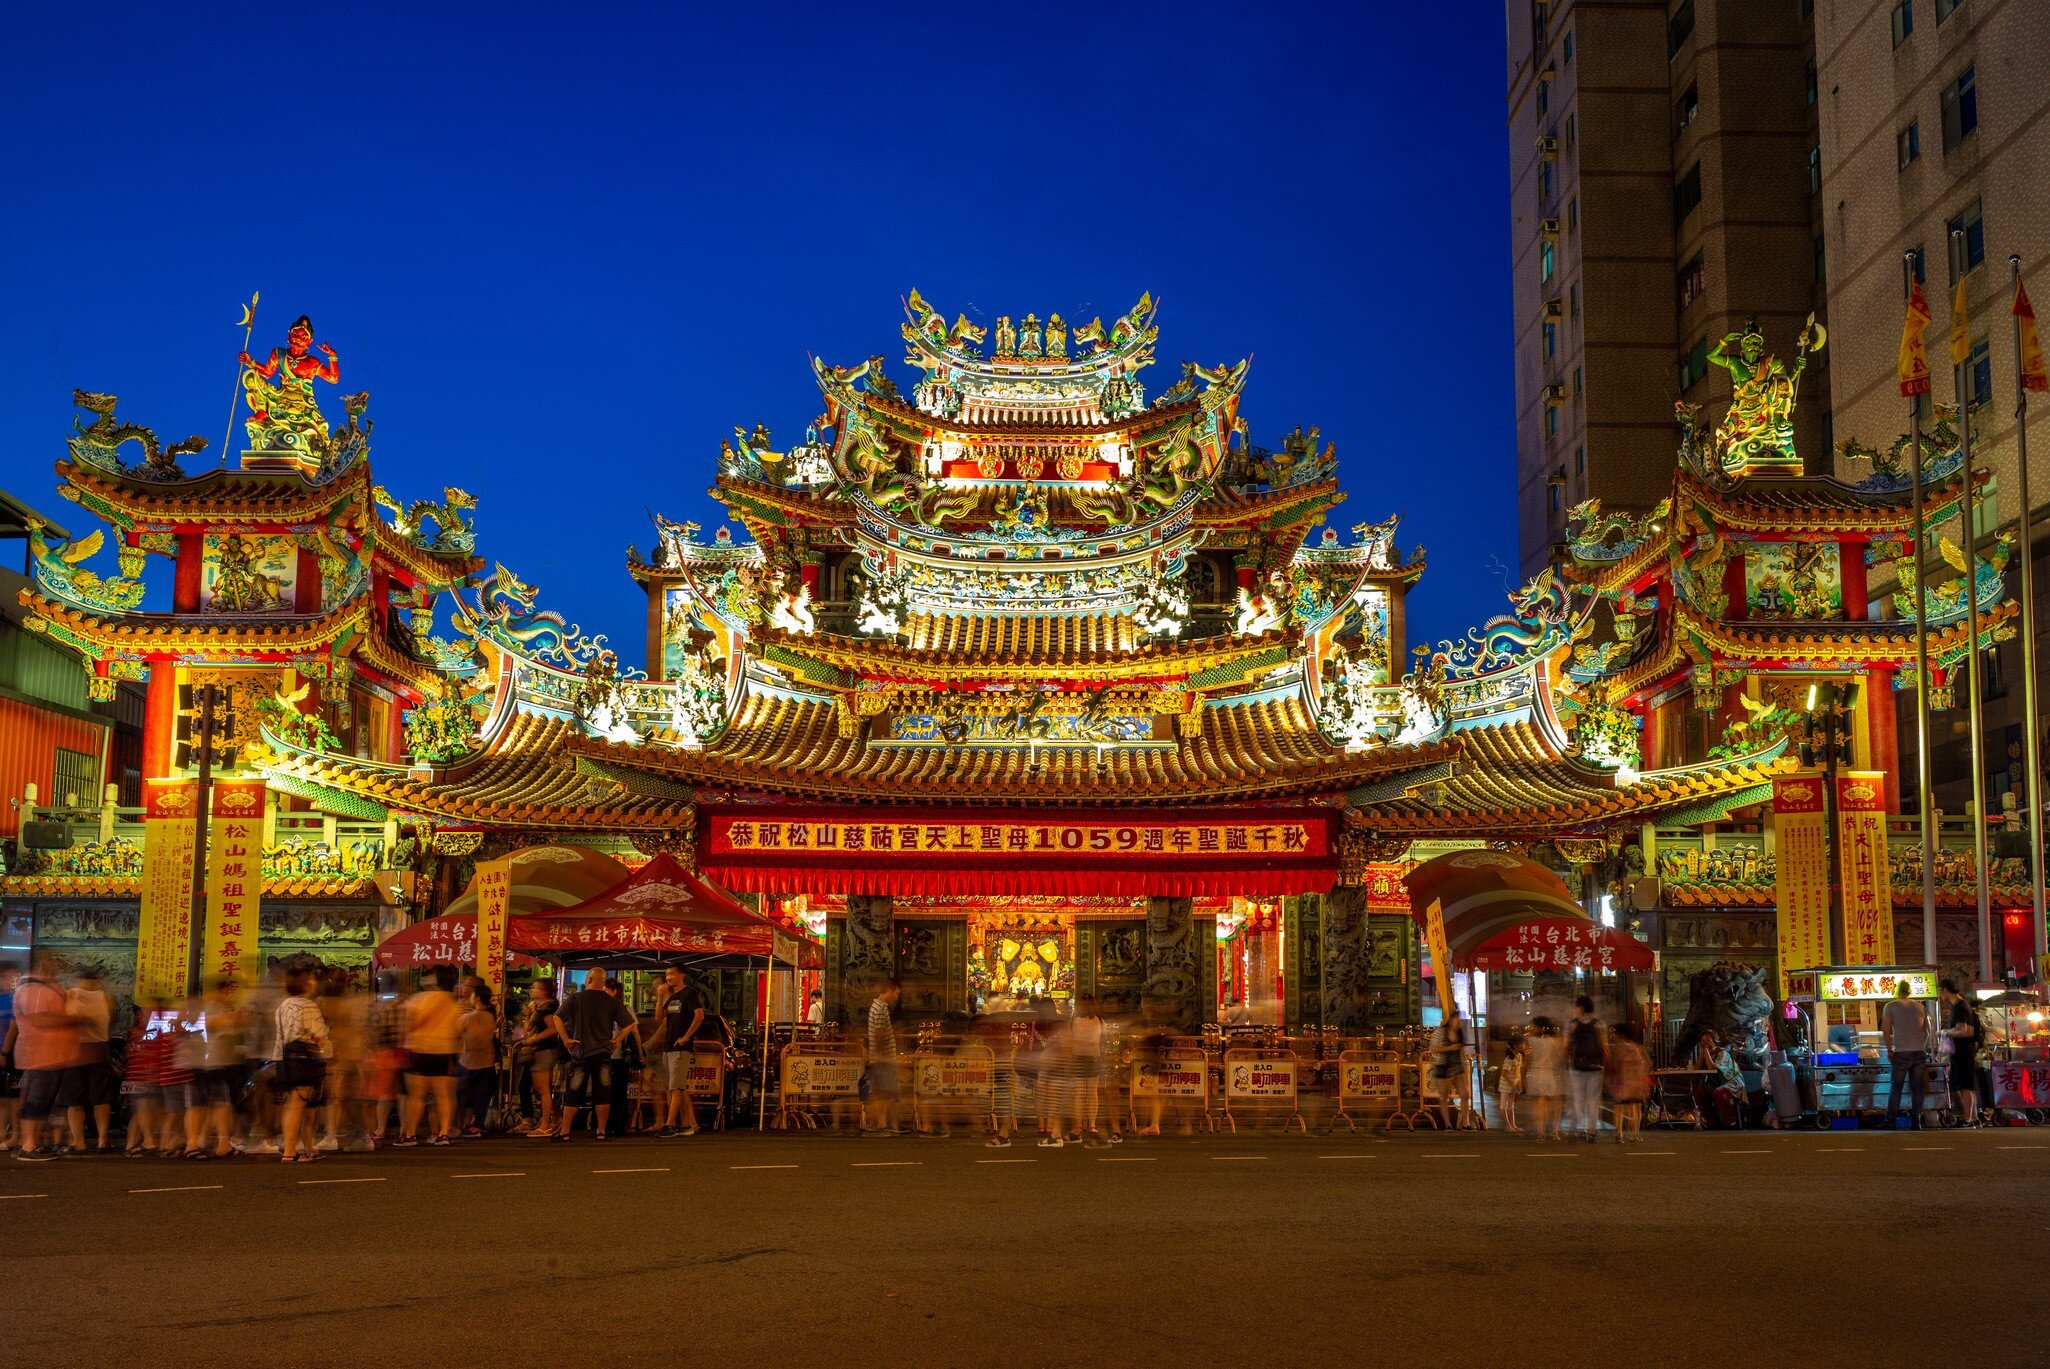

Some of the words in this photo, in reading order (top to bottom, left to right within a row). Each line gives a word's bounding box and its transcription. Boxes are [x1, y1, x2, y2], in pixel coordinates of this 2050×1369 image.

[1843, 817, 1879, 830] 恭祝
[731, 822, 1307, 850] 恭祝松山慈祐宮天上聖母1059週年聖誕千秋
